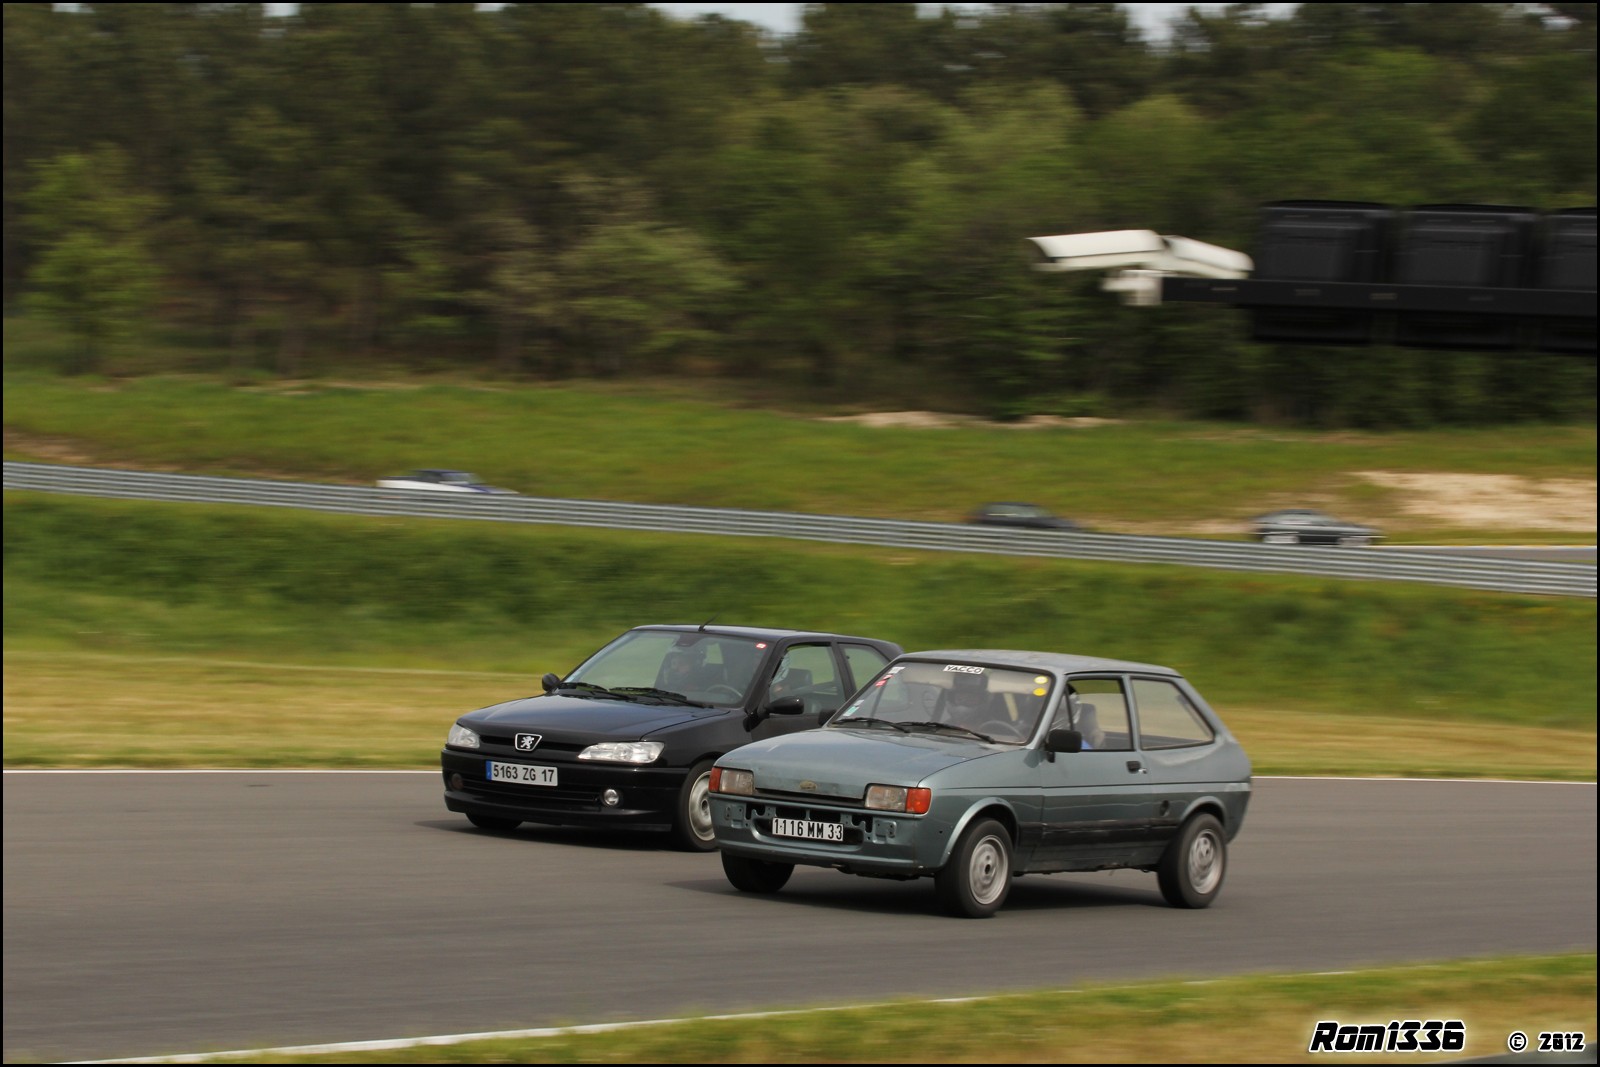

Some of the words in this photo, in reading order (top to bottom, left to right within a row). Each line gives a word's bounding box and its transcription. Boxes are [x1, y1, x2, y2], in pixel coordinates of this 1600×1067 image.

[946, 665, 982, 674] YACCO
[493, 764, 518, 780] 5163
[522, 767, 537, 781] ZG
[541, 769, 555, 783] 17
[774, 818, 804, 837] 1116
[807, 821, 824, 839] MM
[828, 823, 842, 840] 33
